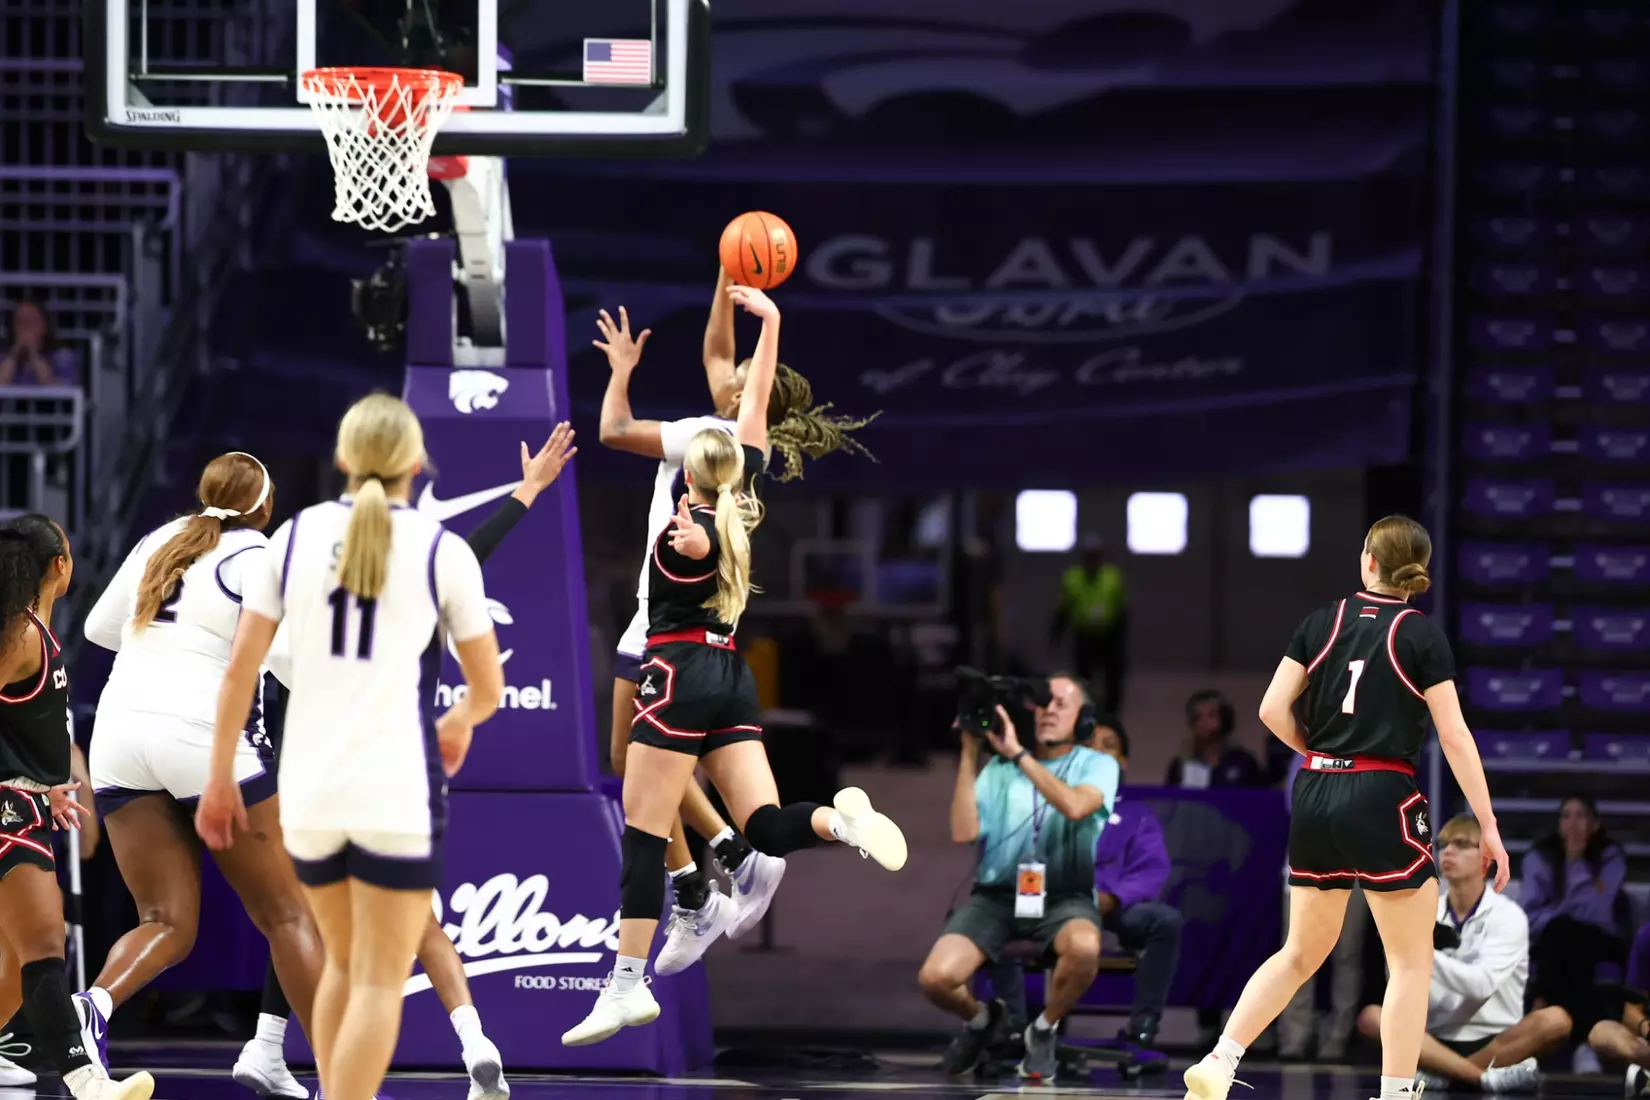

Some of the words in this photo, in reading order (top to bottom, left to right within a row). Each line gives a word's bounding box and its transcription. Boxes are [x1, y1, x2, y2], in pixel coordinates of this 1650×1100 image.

[126, 110, 181, 123] SPALDING
[806, 233, 1334, 290] GLAVAN
[328, 585, 377, 661] 11
[1341, 659, 1366, 715] 1
[514, 975, 556, 990] FOOD
